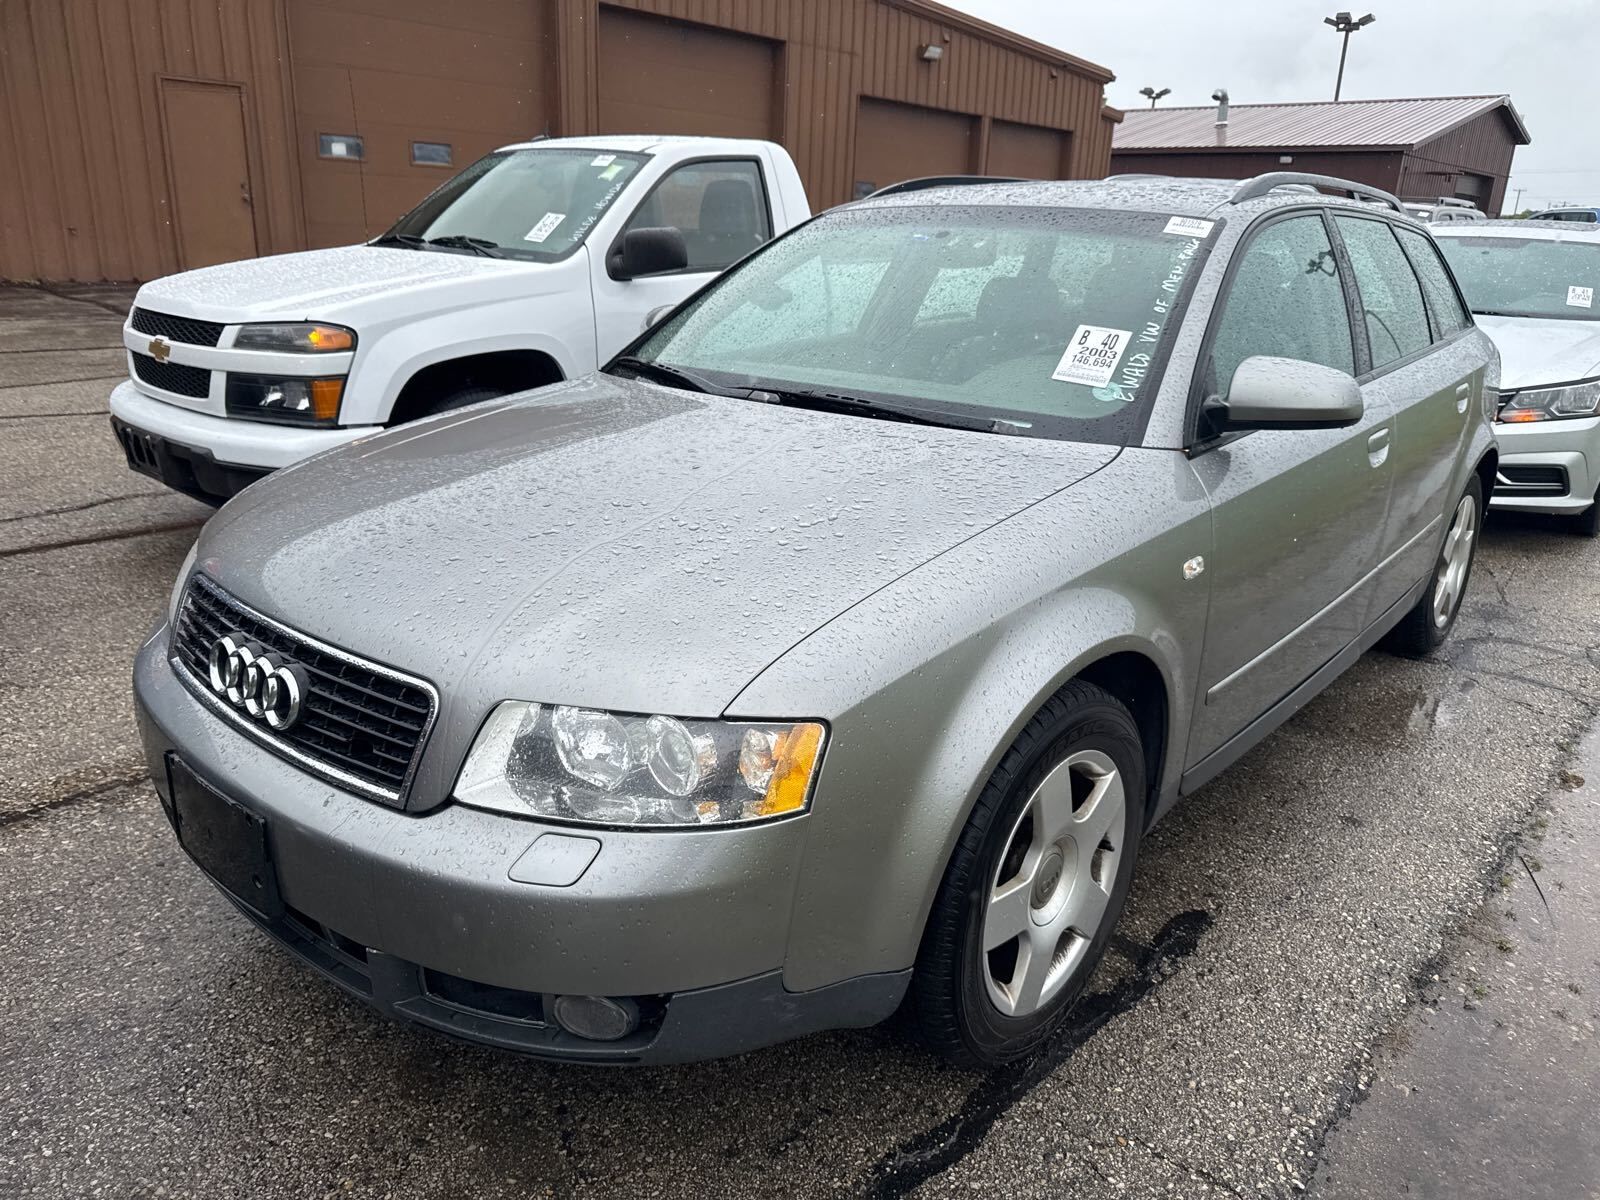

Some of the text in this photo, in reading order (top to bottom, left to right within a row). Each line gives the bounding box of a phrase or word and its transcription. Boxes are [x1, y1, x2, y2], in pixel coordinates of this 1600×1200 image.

[1138, 321, 1161, 344] VW
[1153, 298, 1169, 314] OF
[1078, 330, 1120, 350] B 40
[1071, 354, 1113, 369] 146,694
[1078, 346, 1118, 360] 2003
